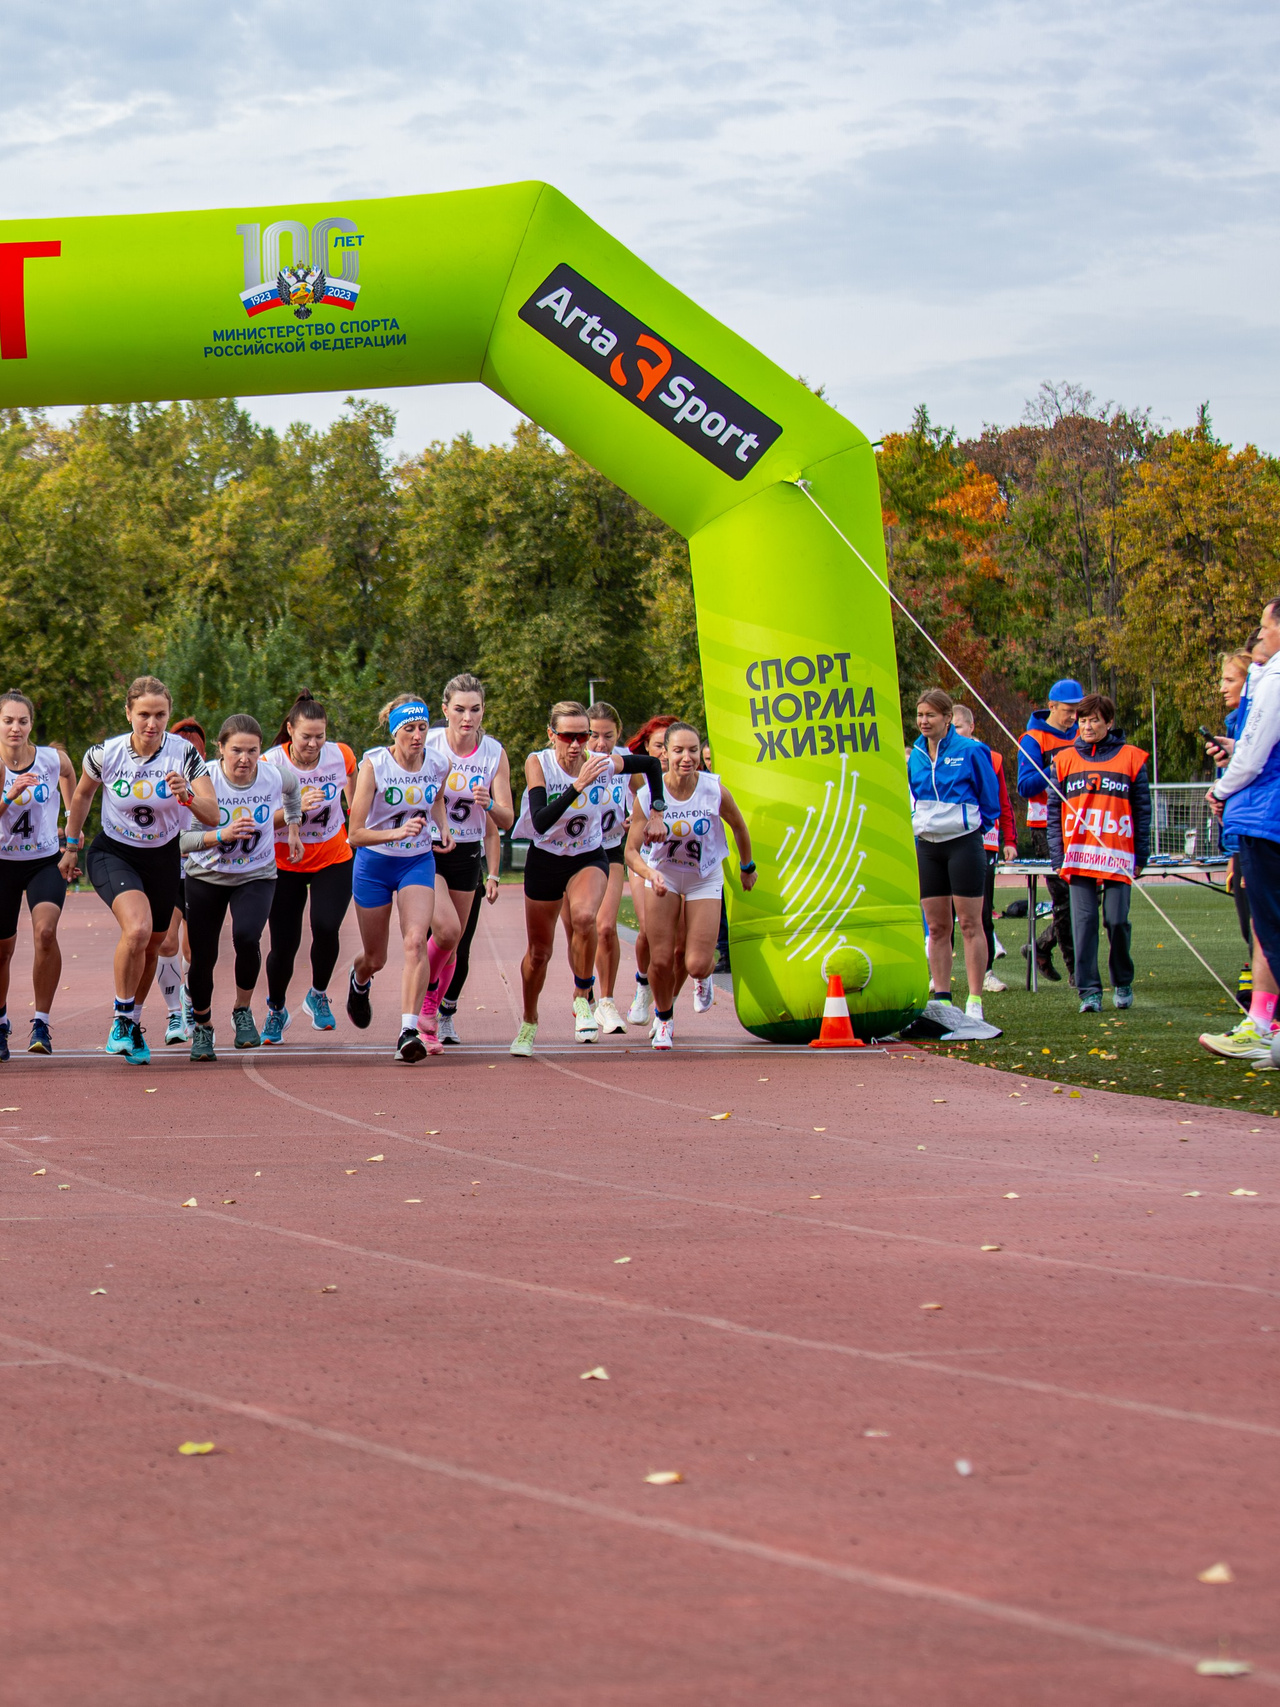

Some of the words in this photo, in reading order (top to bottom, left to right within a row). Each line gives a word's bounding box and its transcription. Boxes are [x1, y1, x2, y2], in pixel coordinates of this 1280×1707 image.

[334, 235, 365, 248] ЛЕТ
[251, 292, 272, 306] 1923
[327, 287, 352, 301] 2023
[212, 321, 336, 343] МИНИСТЕРСТВО
[340, 317, 400, 335] СПОРТА
[203, 337, 306, 358] РОССИЙСКОЙ
[310, 333, 407, 352] ФЕДЕРАЦИИ
[535, 286, 619, 357] Arta
[658, 375, 760, 463] Sport
[745, 652, 852, 692] СПОРТ
[749, 687, 877, 728] НОРМА
[754, 722, 881, 763] ЖИЗНИ
[115, 769, 175, 780] VMARAFON
[300, 773, 337, 785] RAFONE
[452, 762, 487, 775] RAFONE
[217, 794, 272, 806] MARAFONE
[444, 795, 476, 824] 5
[9, 808, 35, 840] 4
[131, 804, 156, 830] 8
[302, 804, 331, 828] 4
[563, 813, 589, 839] 6
[663, 808, 712, 820] ARAFONE
[663, 839, 702, 864] 79
